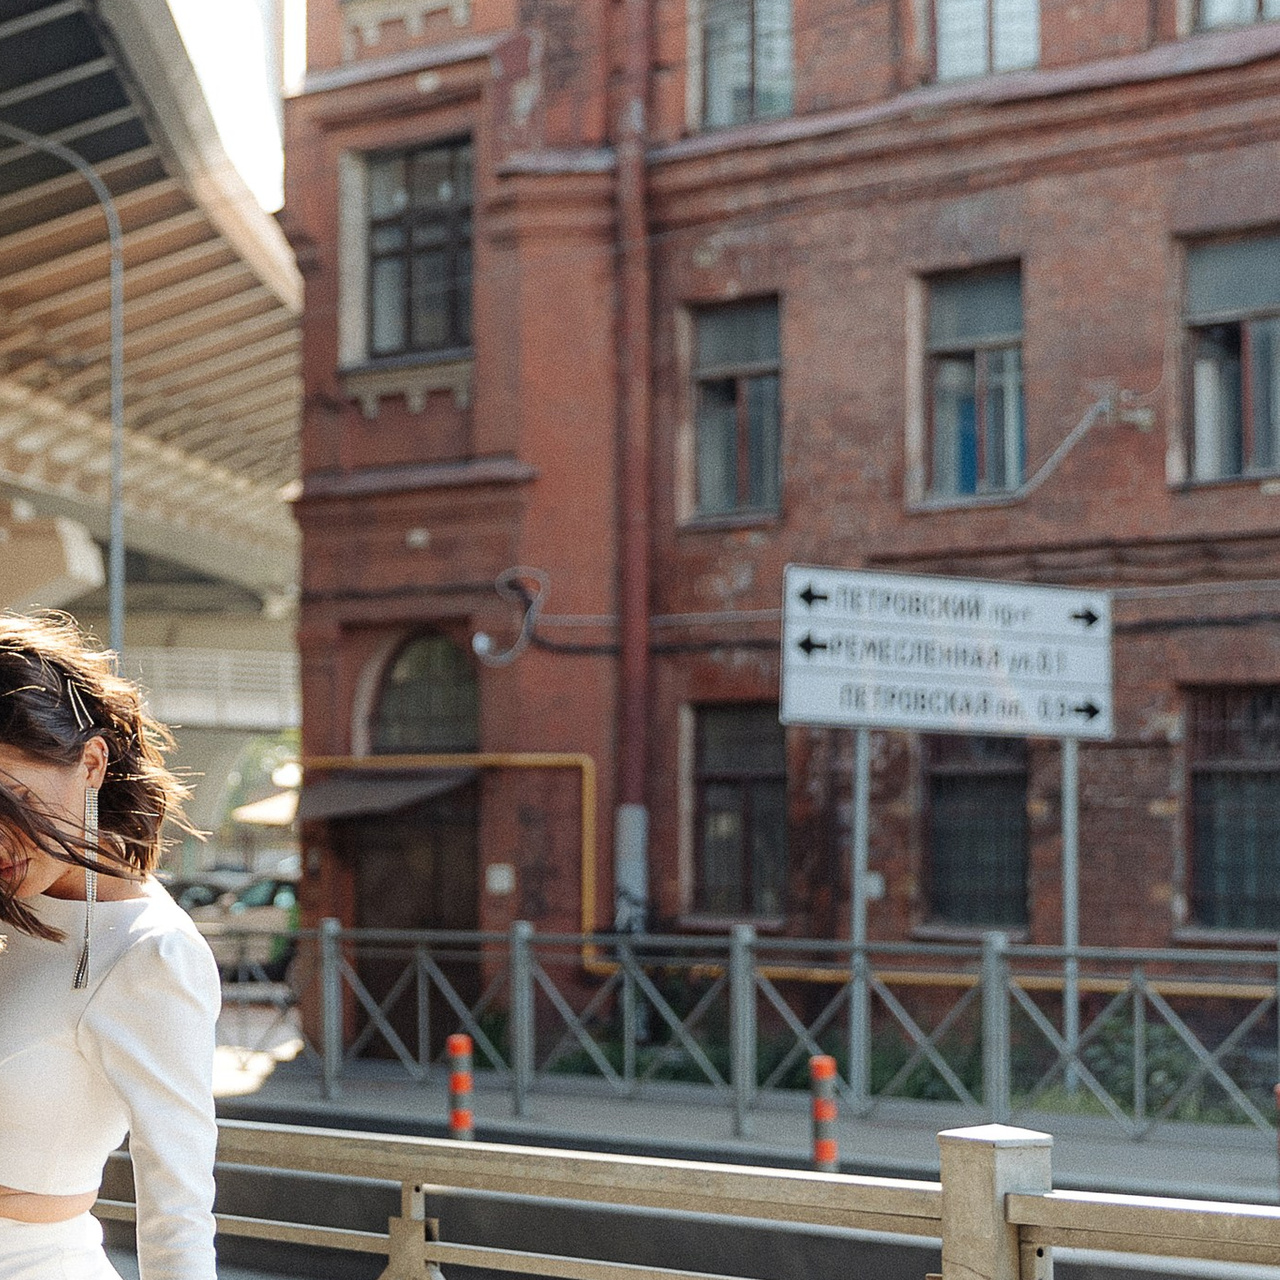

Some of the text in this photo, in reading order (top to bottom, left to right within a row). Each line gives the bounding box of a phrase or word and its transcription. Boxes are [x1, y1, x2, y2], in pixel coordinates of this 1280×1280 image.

[835, 584, 981, 621] ПЕТРОВСКИЙ
[828, 633, 1001, 669] РЕМЕСЛЕННАЯ
[839, 683, 990, 717] ПЕТРОВСКАЯ
